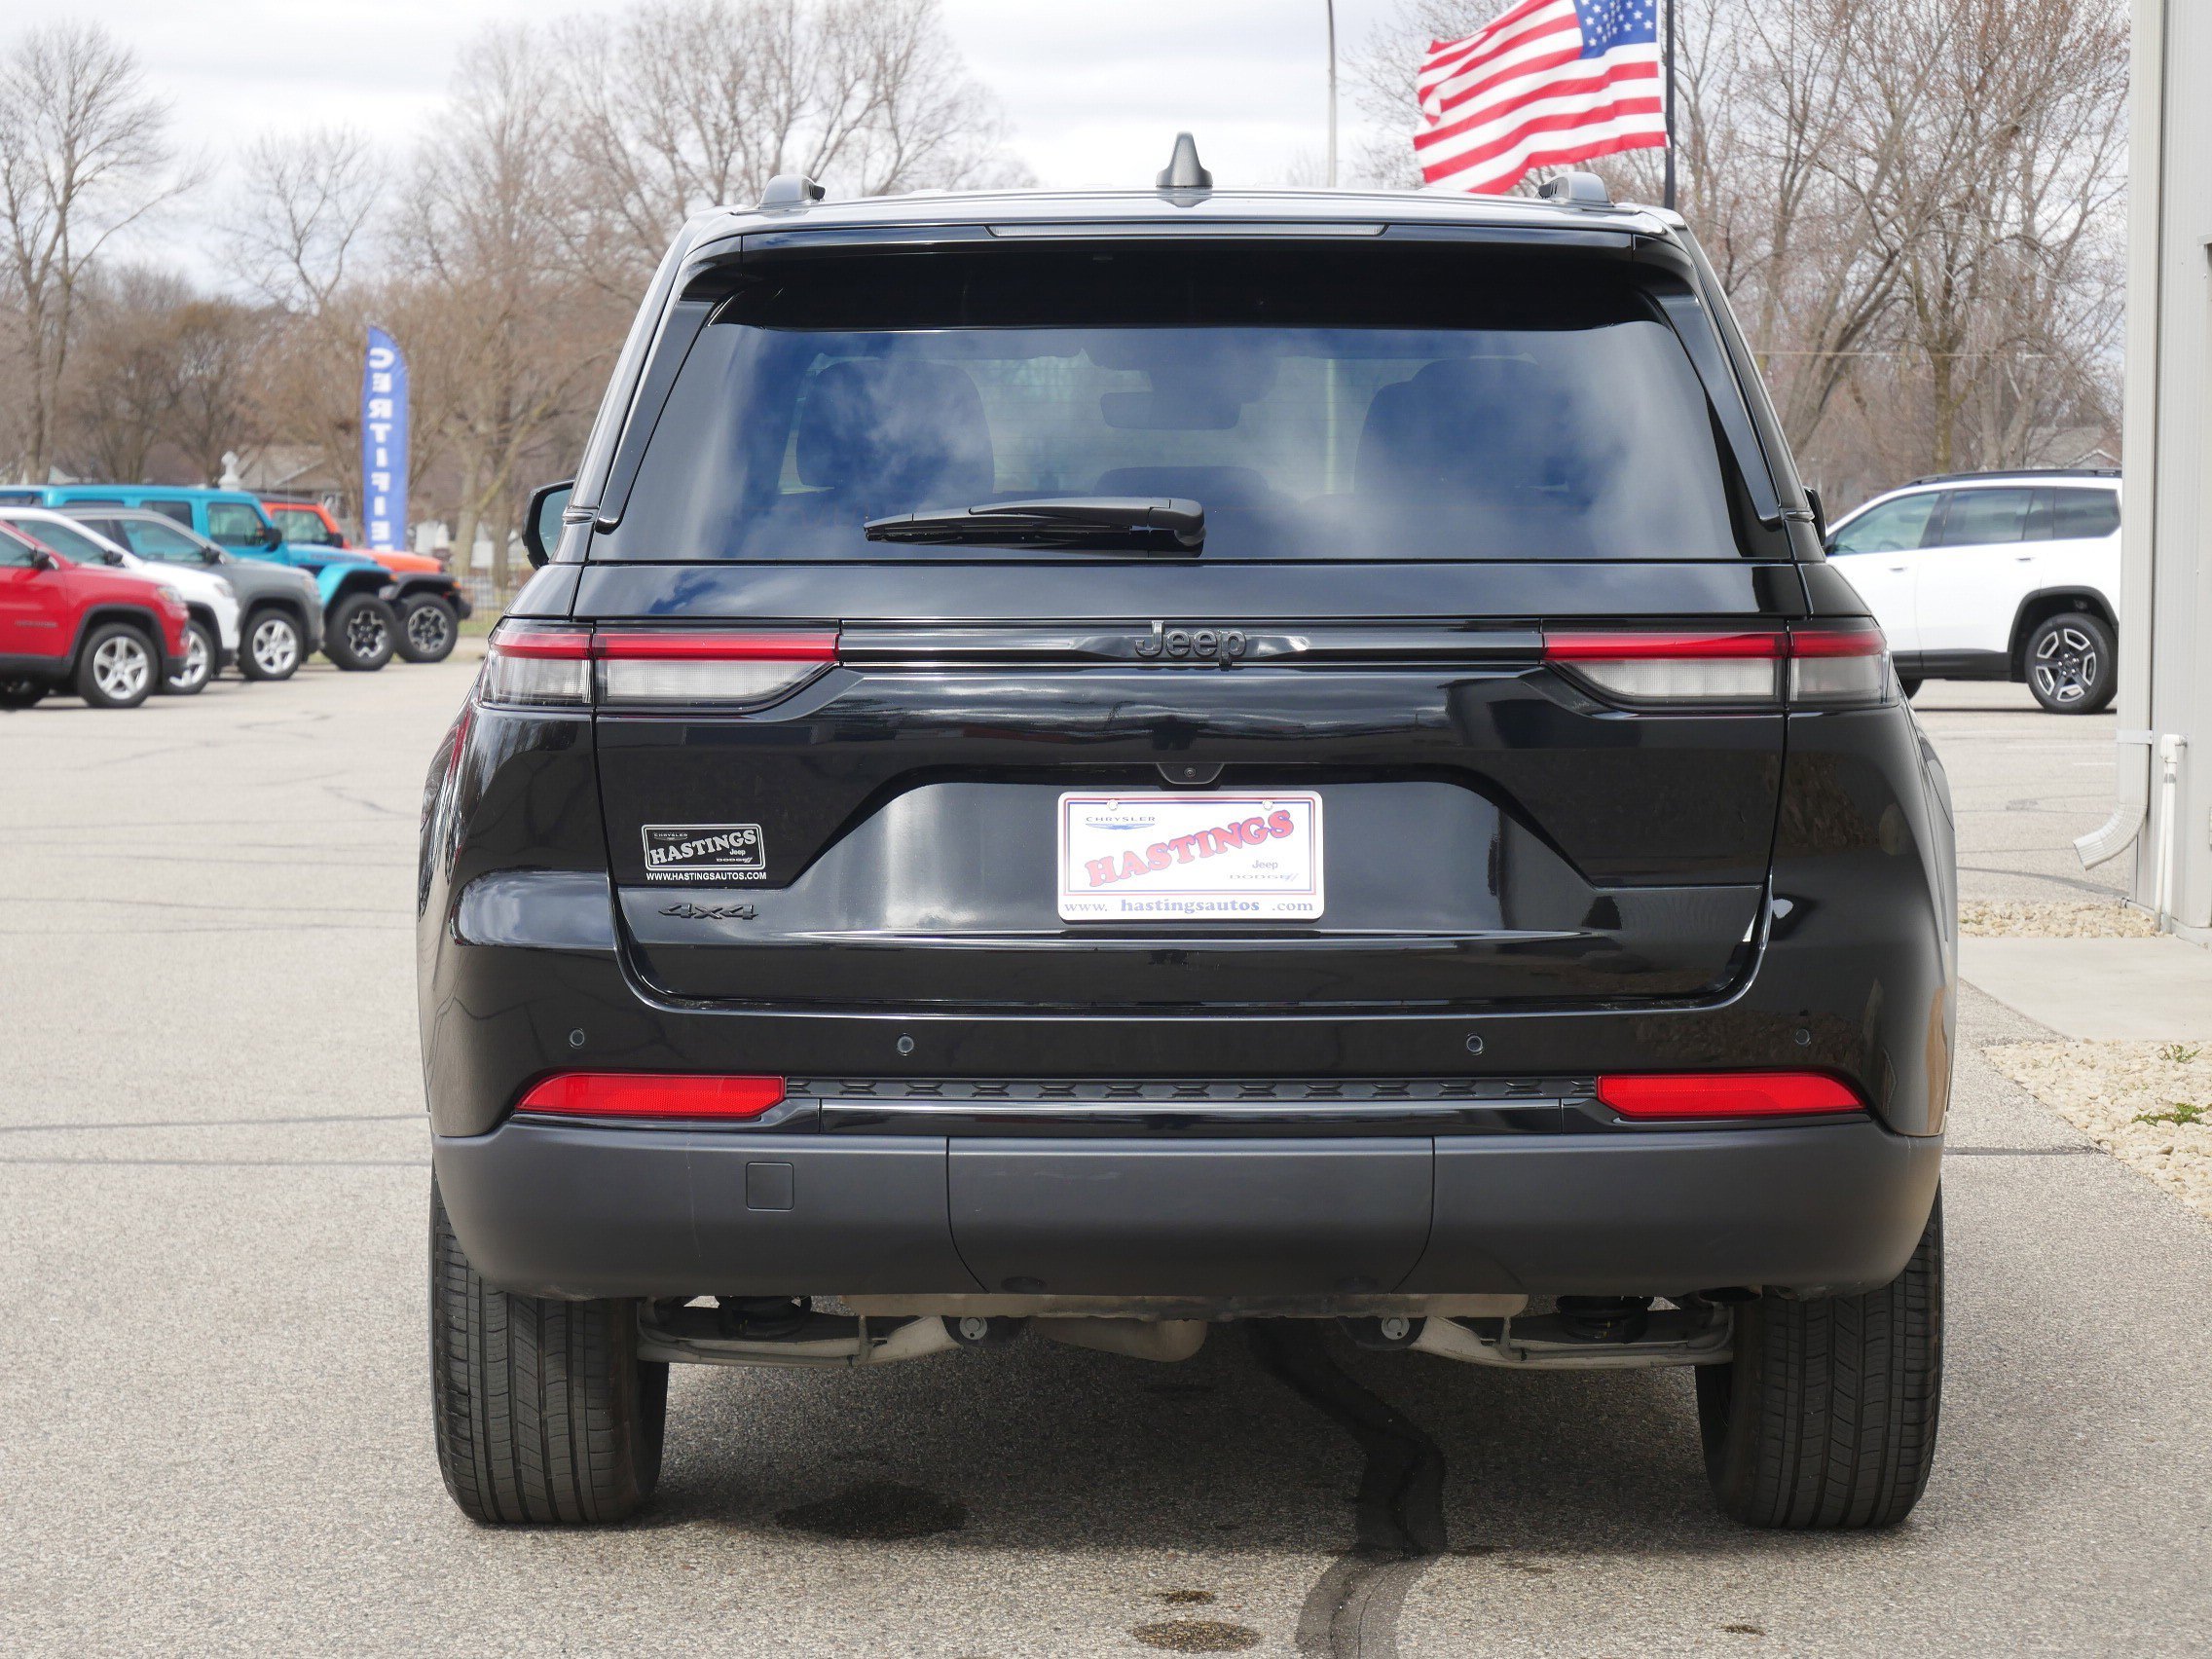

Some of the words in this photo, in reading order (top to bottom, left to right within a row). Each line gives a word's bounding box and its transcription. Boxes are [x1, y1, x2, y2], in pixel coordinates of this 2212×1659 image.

[1134, 619, 1246, 671] Jeep
[650, 830, 756, 865] HASTINGS
[729, 848, 746, 857] Jeep
[1085, 809, 1294, 887] HASTINGS
[1252, 860, 1278, 870] Jeep
[646, 872, 767, 881] WWW.HASTINGSAUTOS.COM
[1064, 903, 1108, 912] www.
[1121, 899, 1260, 914] hastingsautos
[1272, 902, 1313, 911] .com
